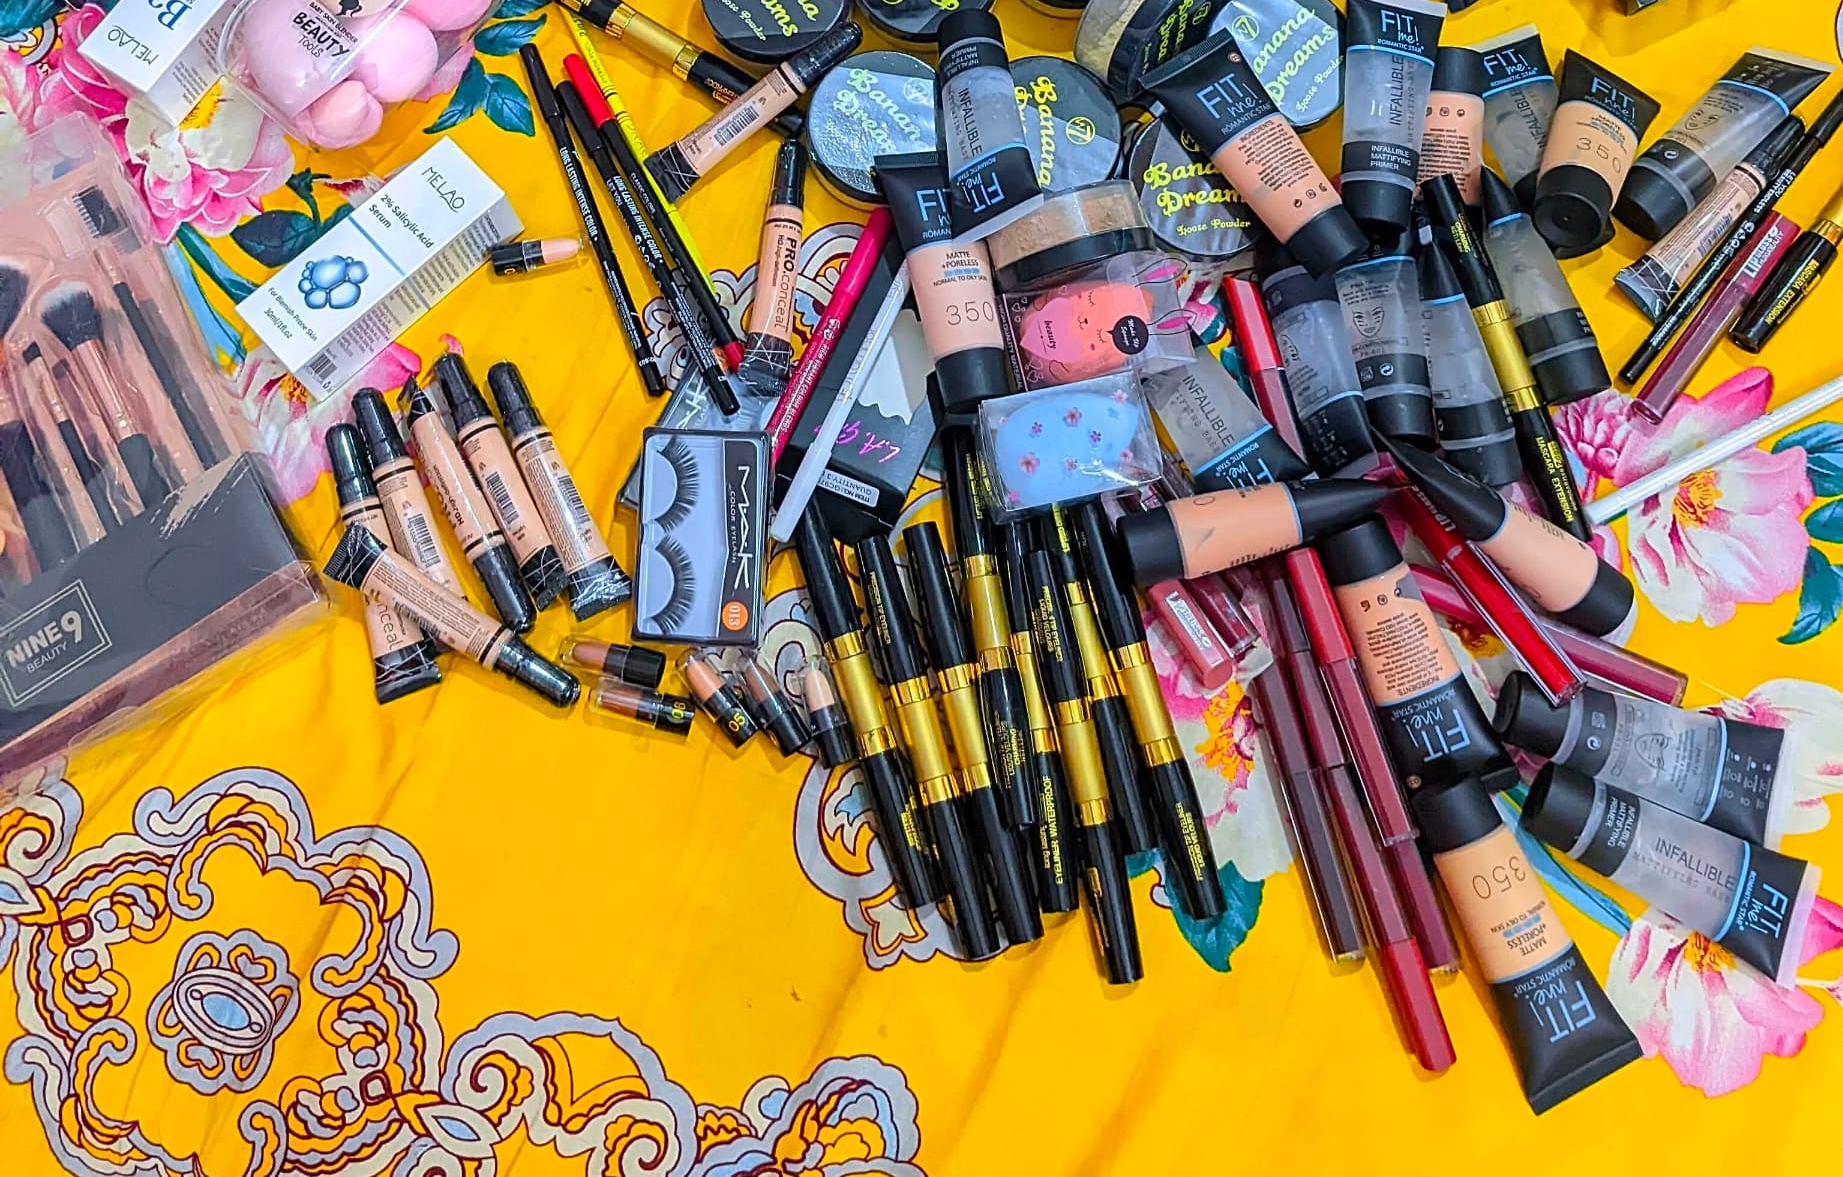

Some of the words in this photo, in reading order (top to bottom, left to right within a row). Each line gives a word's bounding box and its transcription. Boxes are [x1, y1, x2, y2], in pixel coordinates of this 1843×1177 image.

[292, 11, 350, 58] BEAUTY
[739, 8, 766, 41] Powder
[107, 23, 158, 65] MELAO
[1484, 49, 1518, 75] FIT
[1268, 26, 1336, 107] Dreams
[1197, 74, 1242, 119] FIT
[1389, 55, 1404, 126] INFALLIBLE
[1591, 78, 1635, 109] FIT
[958, 88, 982, 156] INFALLIBLE
[1030, 76, 1058, 190] Banana
[1370, 152, 1411, 167] MATTIFYING
[1370, 161, 1399, 170] PRIMER
[1371, 145, 1409, 158] INFALLIBLE
[1576, 137, 1622, 174] 350
[422, 166, 465, 213] MELAO
[368, 205, 392, 229] Serum
[380, 194, 394, 209] 2%
[390, 204, 420, 235] Salicylic
[416, 232, 435, 249] Acid
[1211, 219, 1251, 229] Powder
[946, 251, 971, 260] MATTE
[775, 237, 798, 329] PRO.conceal
[1792, 263, 1819, 290] MASCARA
[268, 288, 277, 298] For
[276, 296, 295, 316] Blemish
[946, 302, 993, 326] 350
[1766, 288, 1798, 324] EXTENSION
[1044, 319, 1057, 349] beauty
[1183, 375, 1235, 447] INFALLIBLE
[1535, 437, 1556, 478] MASCARA
[1552, 477, 1574, 522] EXTENSION
[8, 622, 60, 669] NINE
[60, 611, 82, 645] 9
[26, 641, 68, 673] BEAUTY
[728, 714, 745, 732] 05
[1605, 796, 1619, 827] PRIMER
[1472, 856, 1526, 899] 350
[1654, 836, 1735, 891] INFALLIBLE
[1761, 883, 1790, 940] FIT
[1519, 938, 1547, 956] MATTE
[1549, 980, 1597, 1044] FIT
